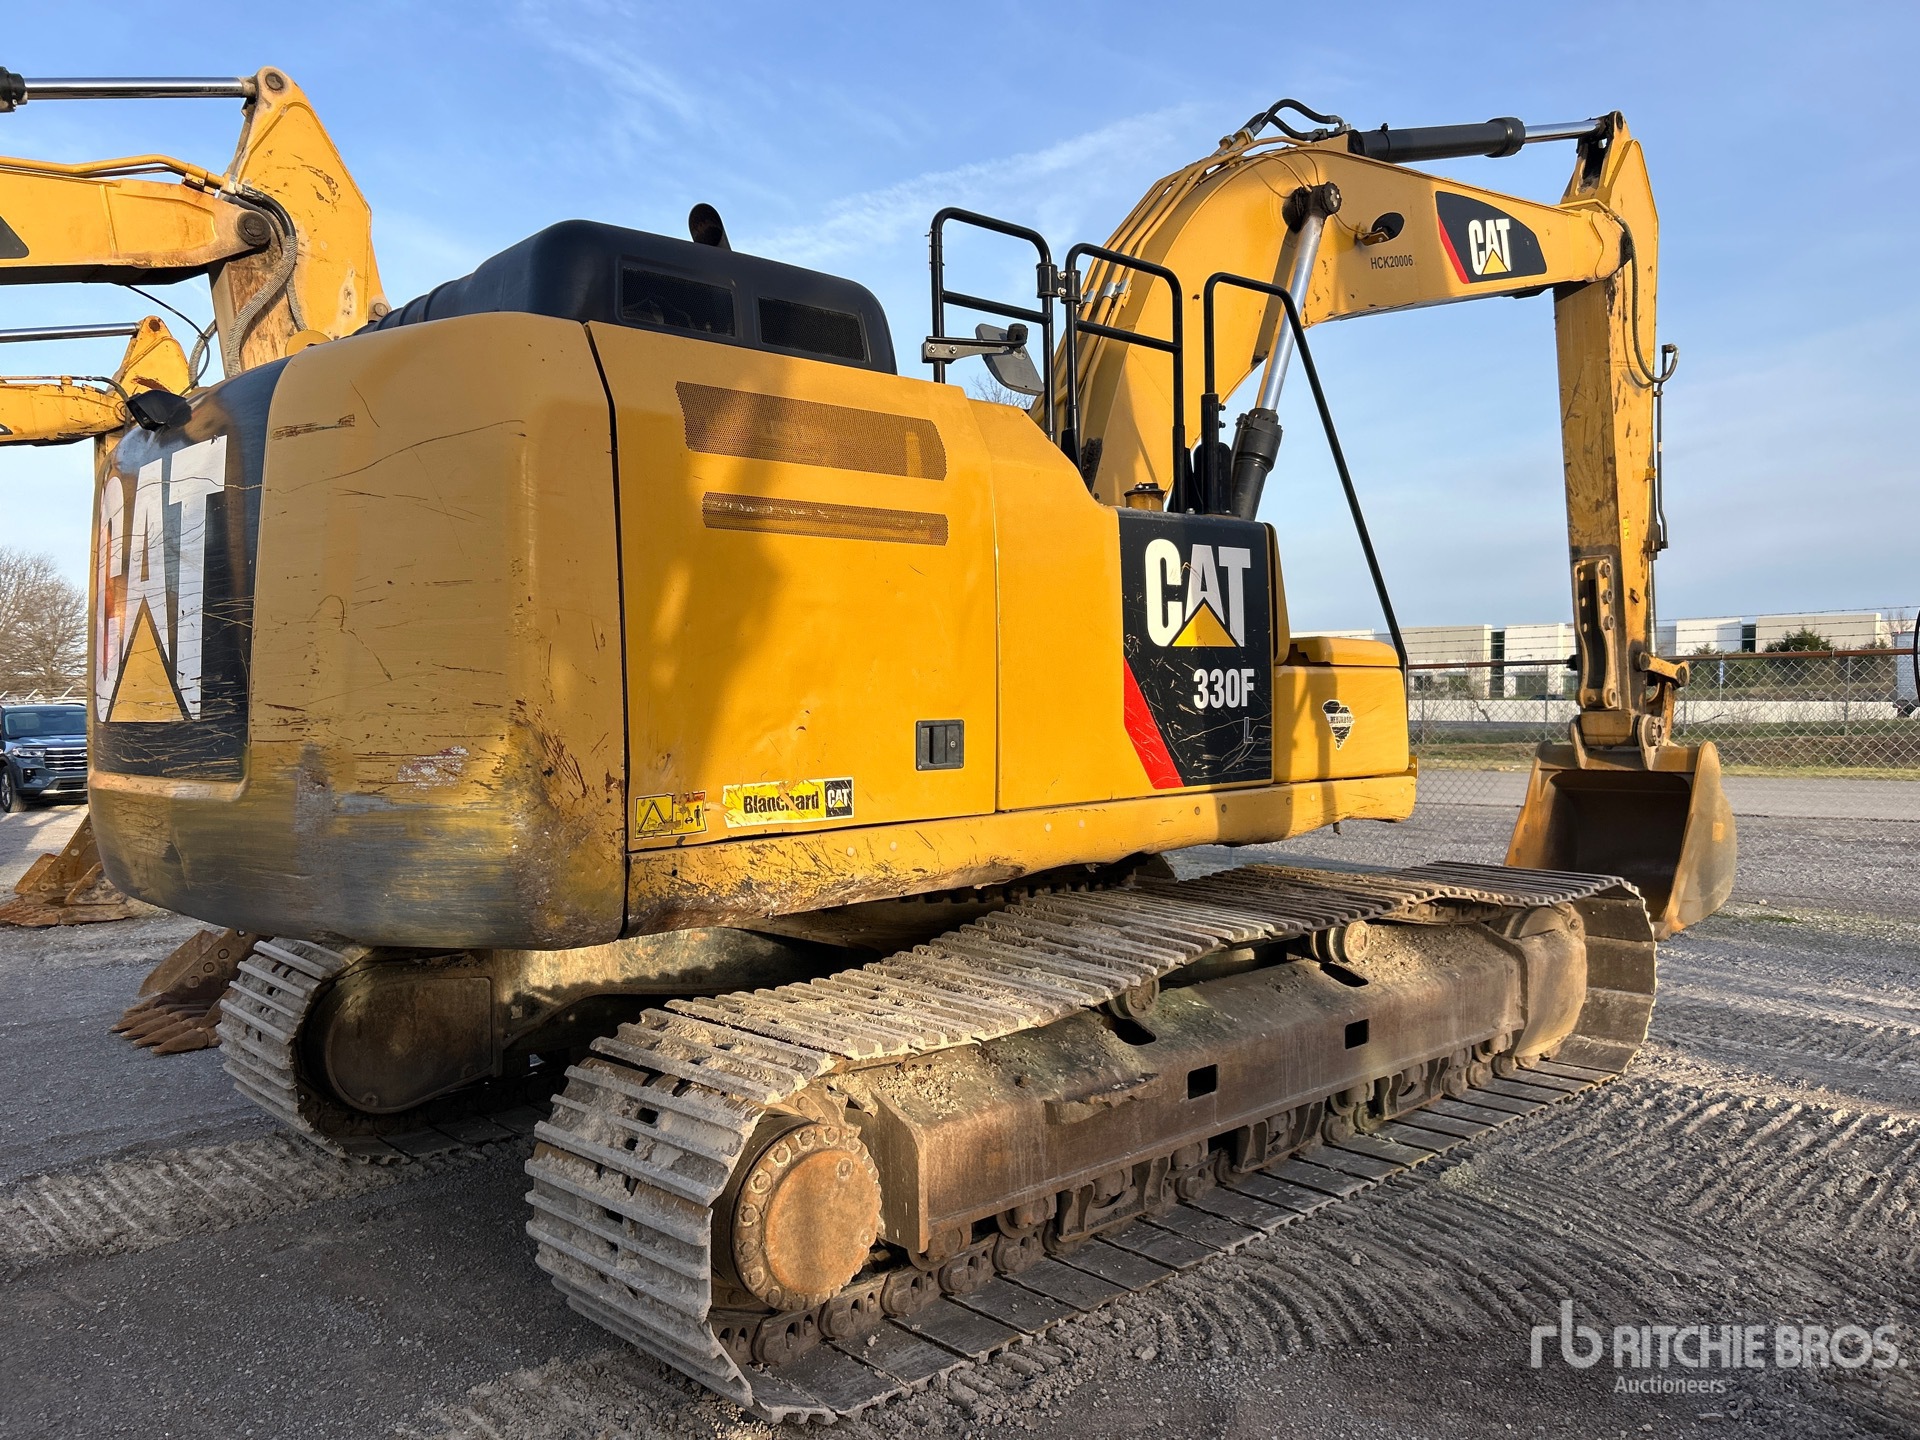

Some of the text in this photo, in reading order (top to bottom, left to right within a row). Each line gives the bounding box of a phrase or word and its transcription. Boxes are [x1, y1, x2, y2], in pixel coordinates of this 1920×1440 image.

[1370, 254, 1414, 270] HCK20006
[1468, 218, 1512, 275] CAT
[96, 435, 227, 723] CAT
[1145, 538, 1251, 647] CAT
[1193, 668, 1255, 709] 330F
[827, 788, 850, 807] CAT
